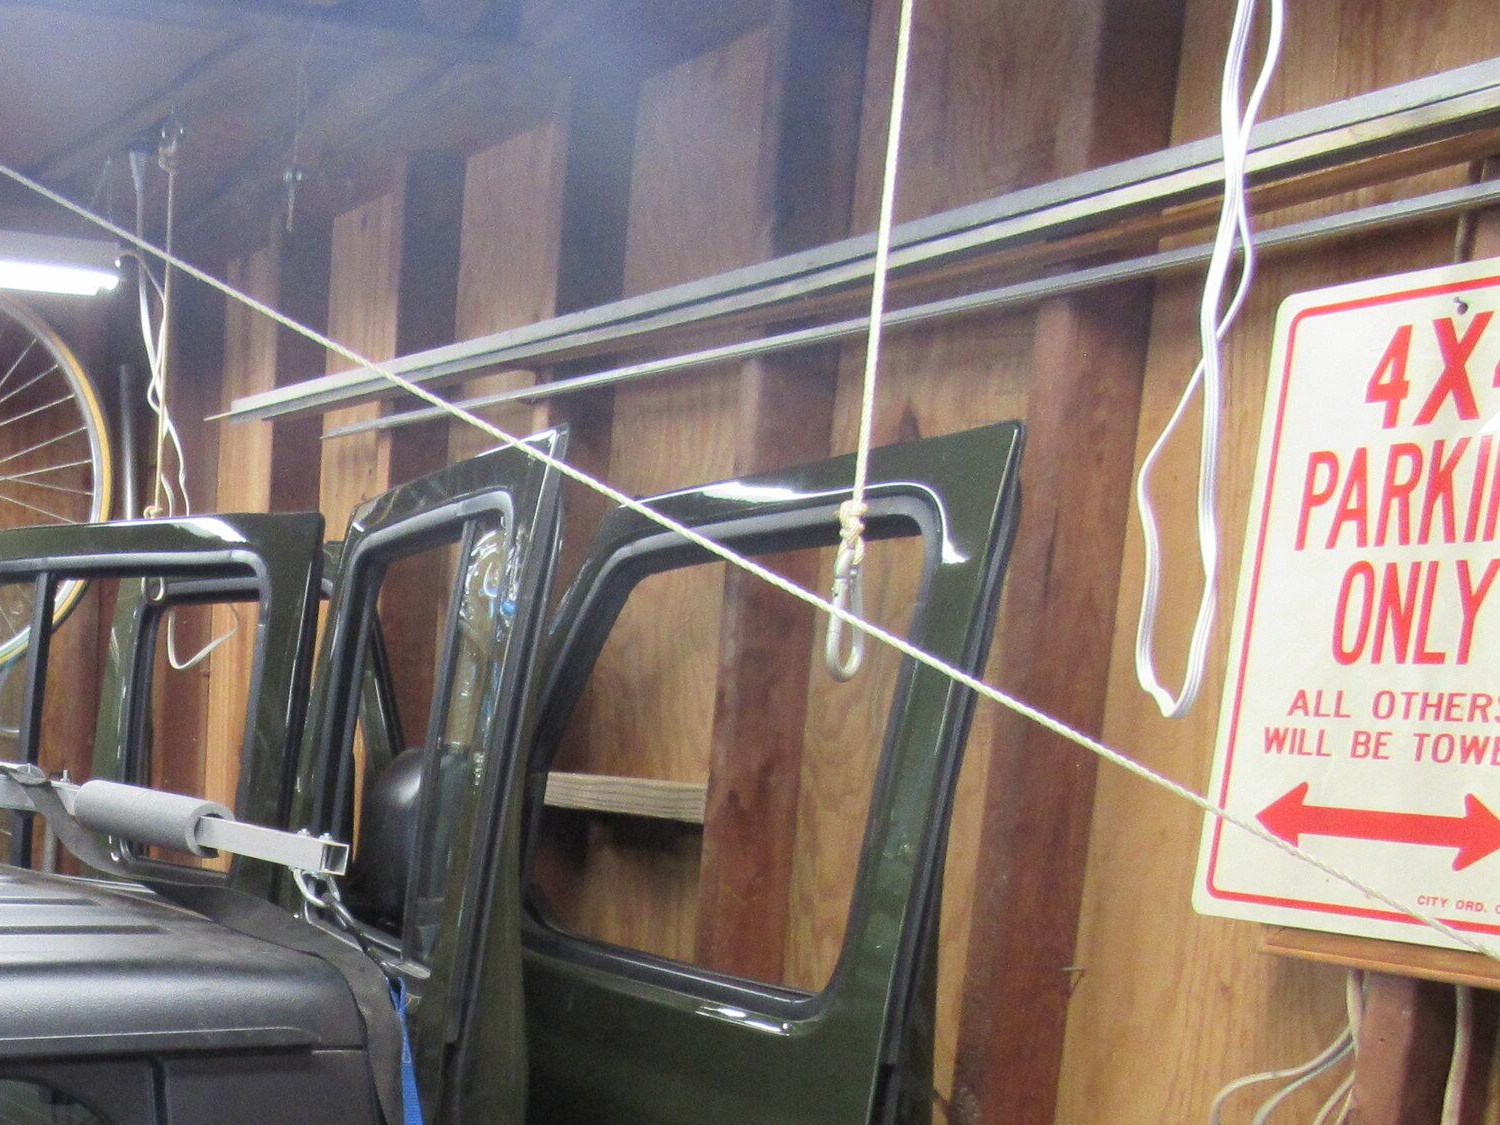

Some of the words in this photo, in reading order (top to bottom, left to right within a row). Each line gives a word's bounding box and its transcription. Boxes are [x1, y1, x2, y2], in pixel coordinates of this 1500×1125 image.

[1364, 310, 1500, 429] 4X
[1332, 559, 1500, 666] ONLY
[1287, 689, 1351, 718] ALL
[1372, 690, 1500, 723] OTHER
[1263, 727, 1332, 757] WILL
[1350, 730, 1393, 760] BE
[1417, 895, 1448, 908] CITY
[1455, 899, 1487, 913] ORD.
